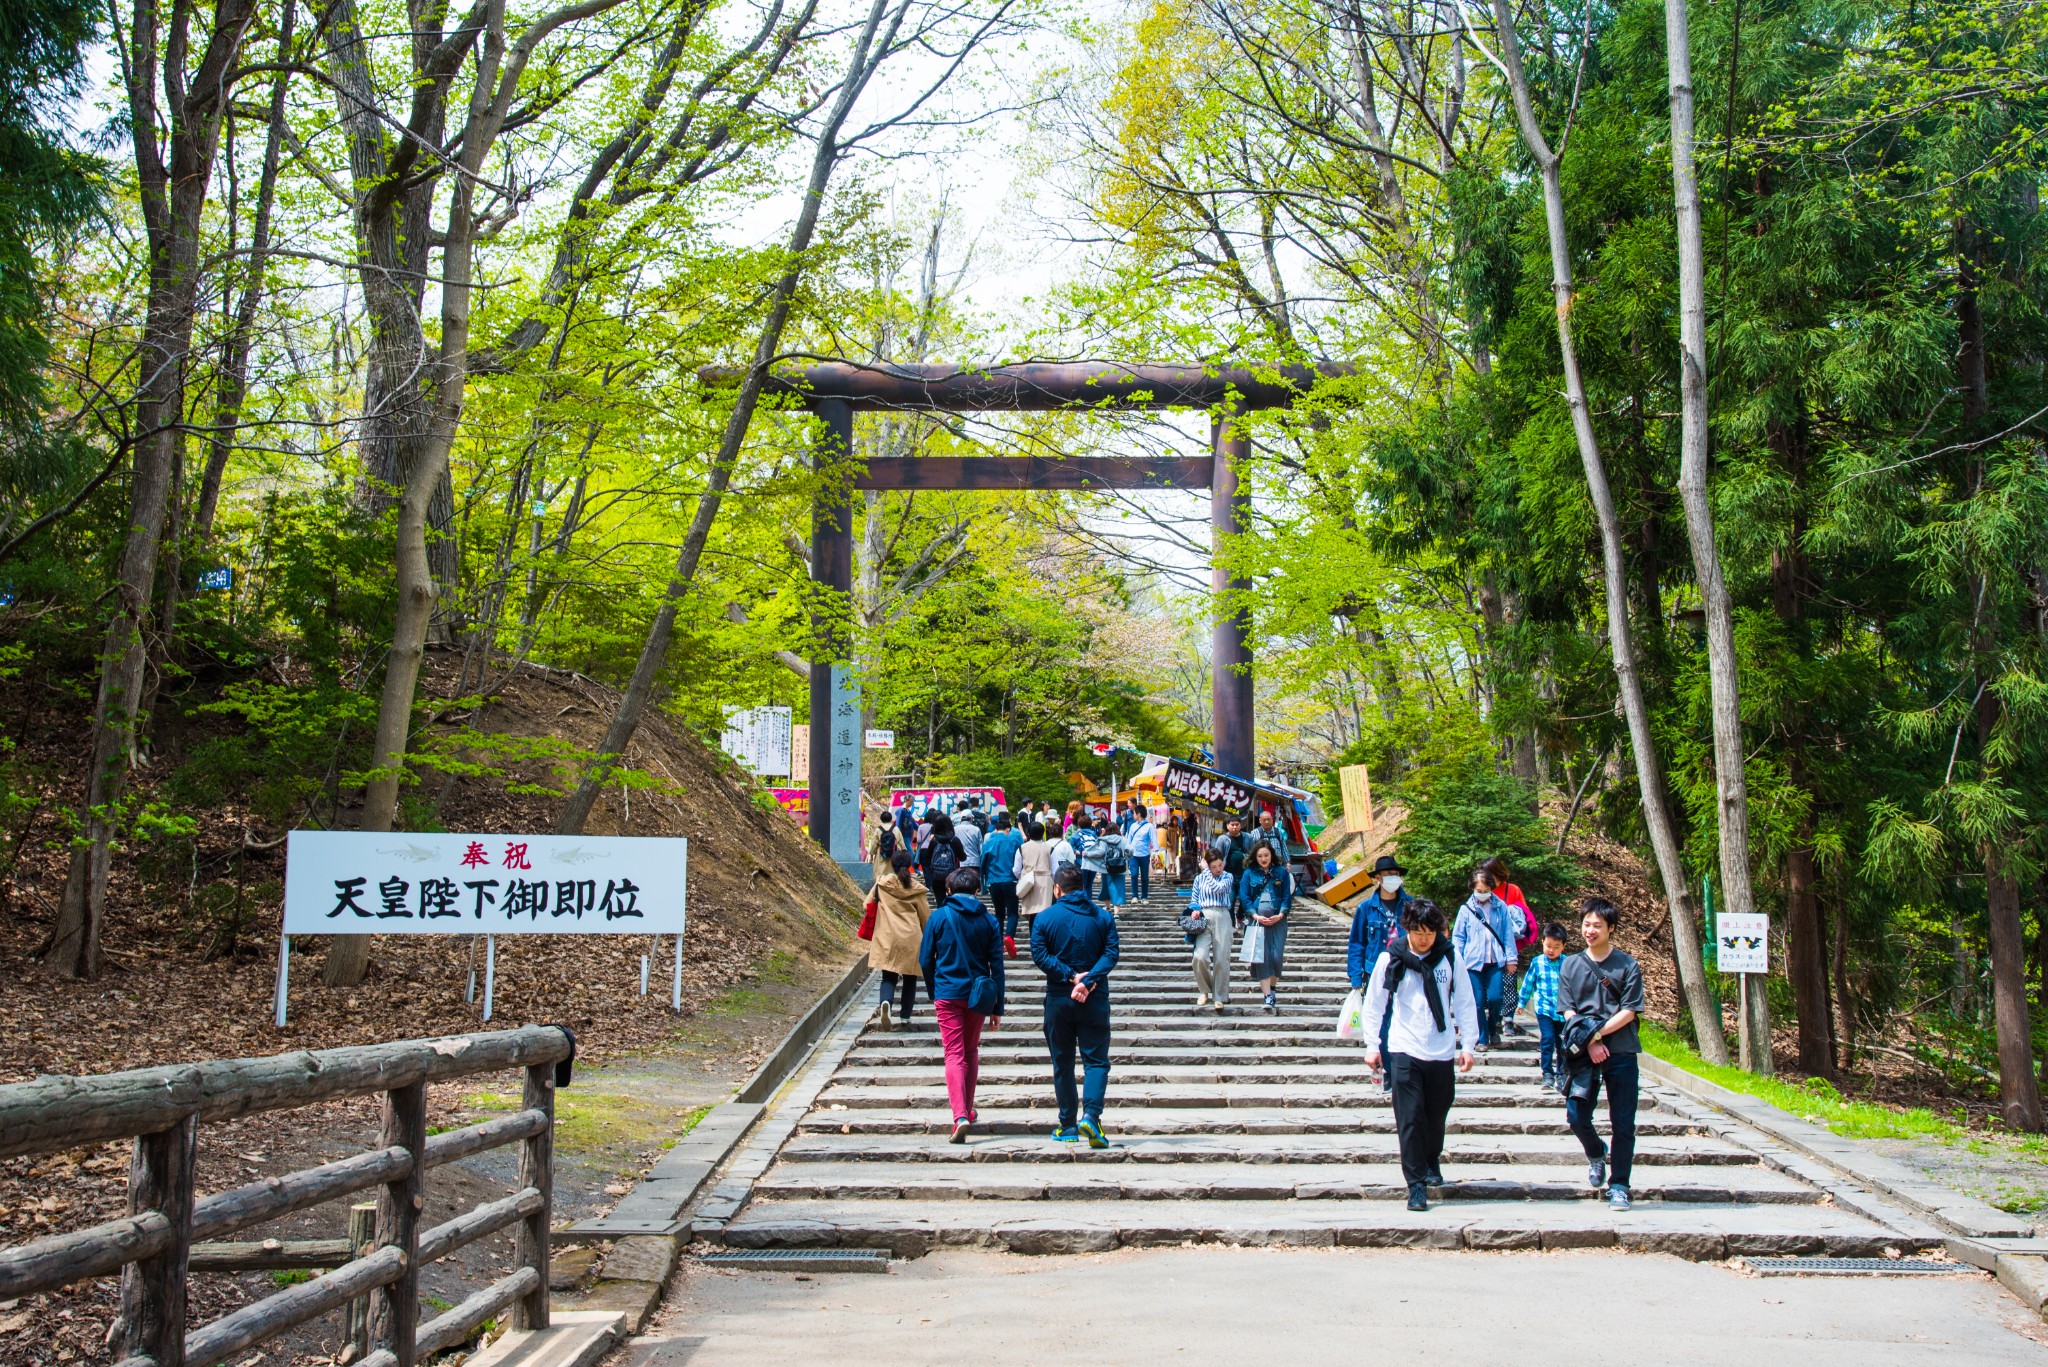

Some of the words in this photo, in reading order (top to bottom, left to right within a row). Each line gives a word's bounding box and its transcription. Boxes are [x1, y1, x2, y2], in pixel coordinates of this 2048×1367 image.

[1167, 768, 1250, 808] MEGAチキン
[1194, 796, 1210, 806] MEGA
[1224, 806, 1240, 815] MEGA
[459, 841, 532, 870] 奉祝
[325, 875, 644, 921] 天皇陛下御即位
